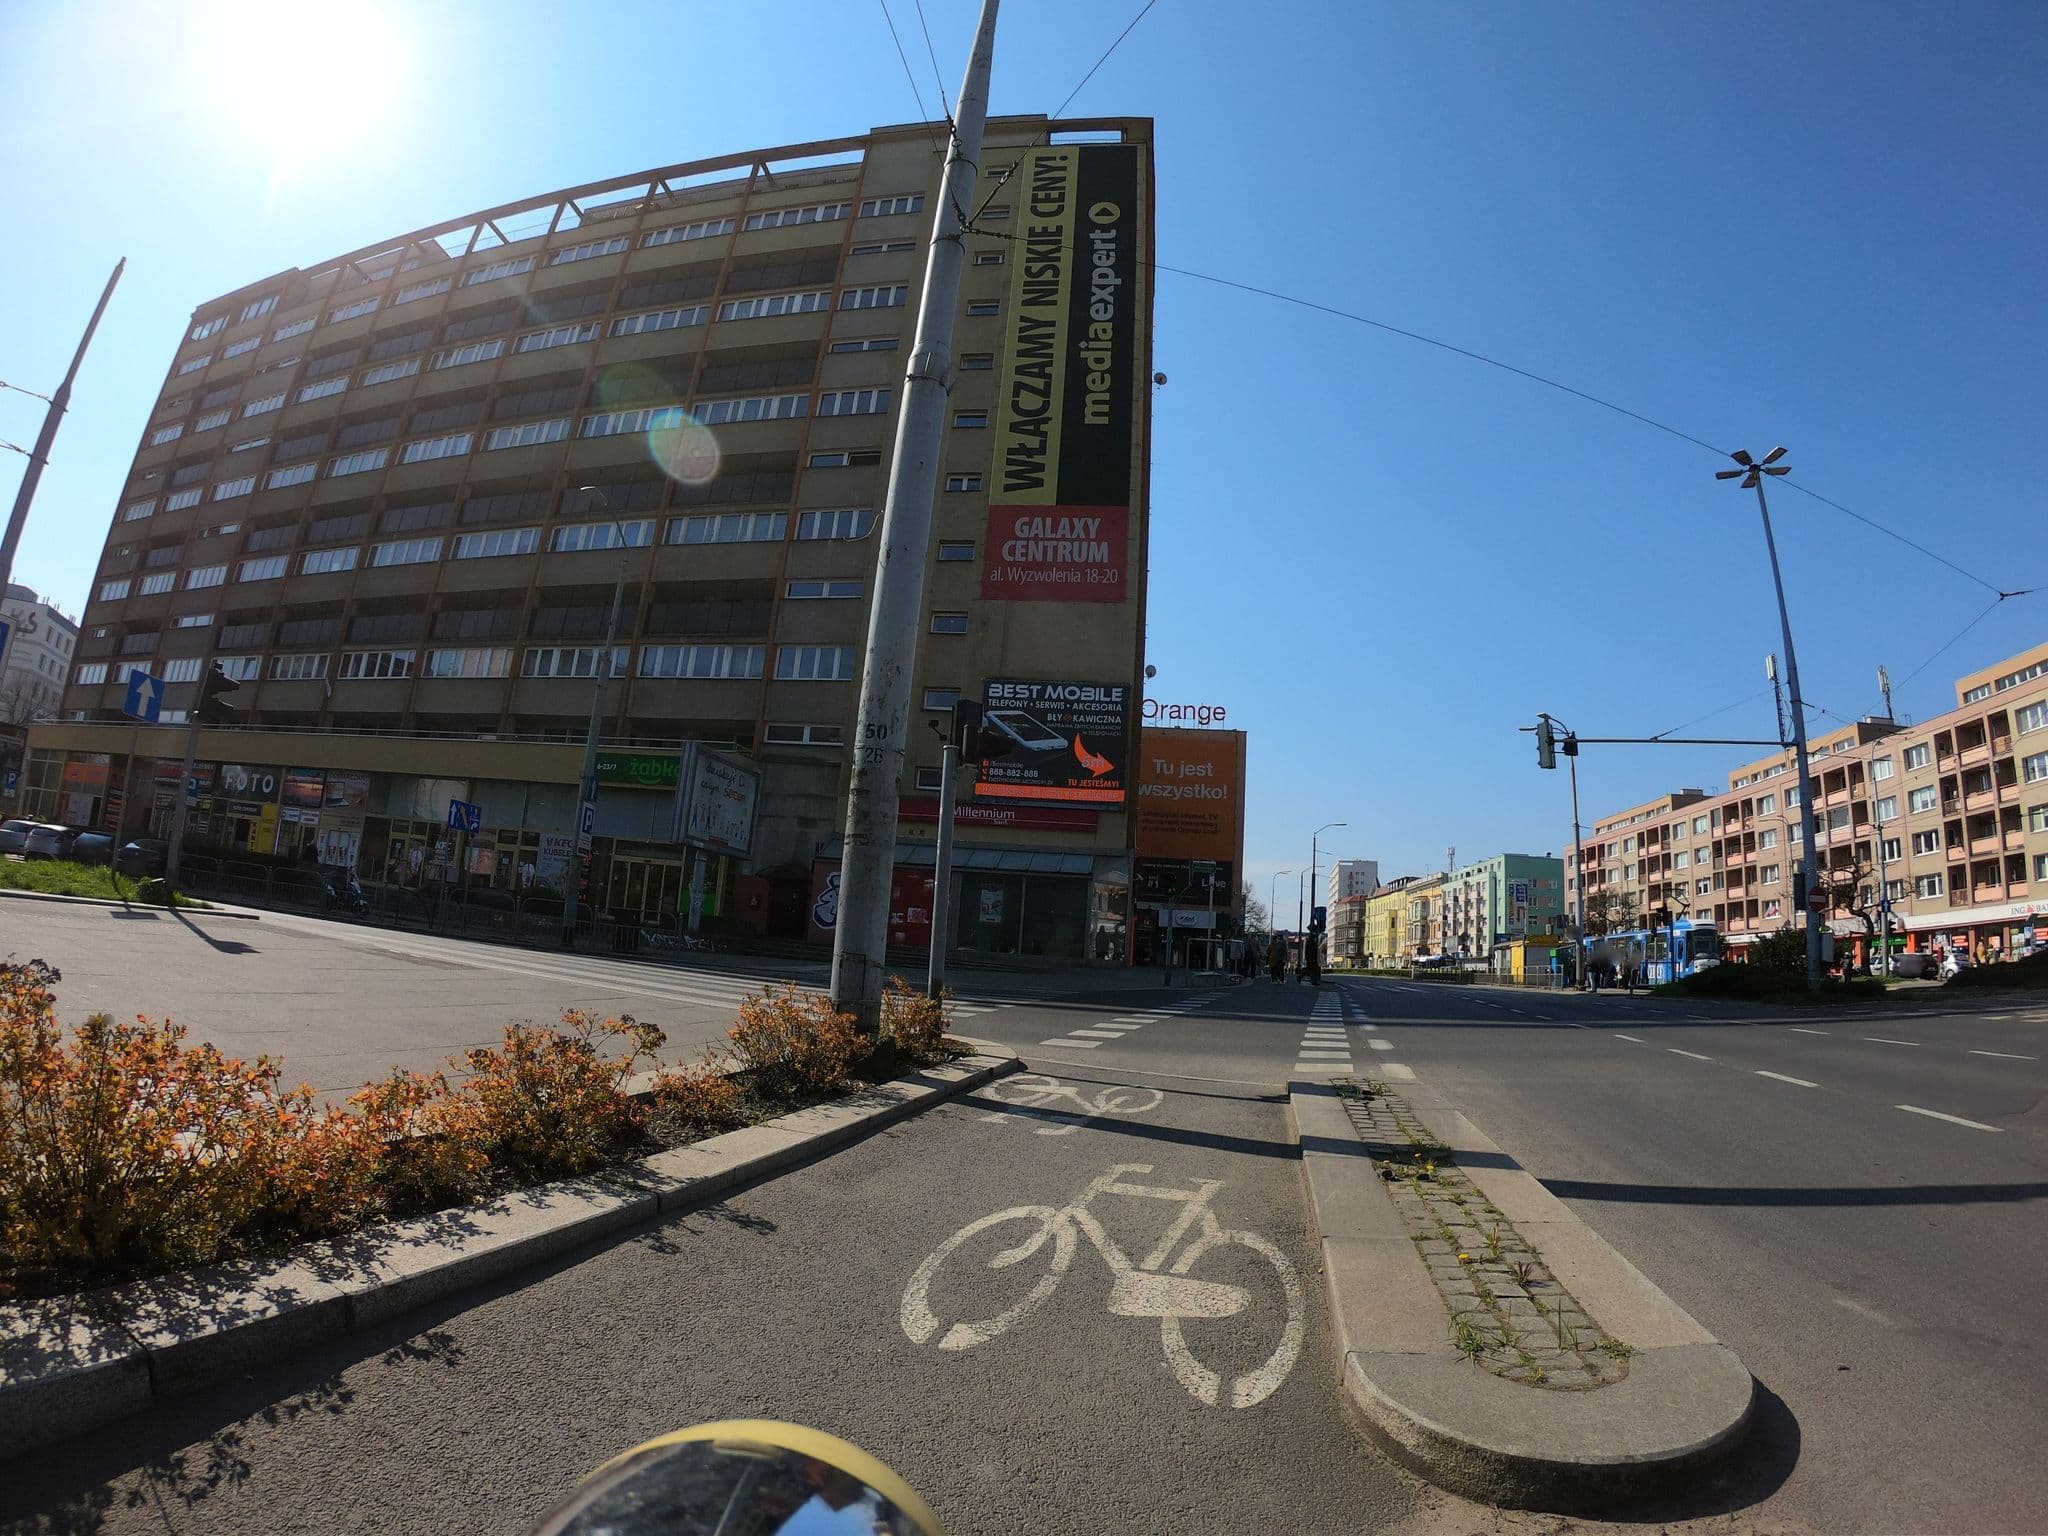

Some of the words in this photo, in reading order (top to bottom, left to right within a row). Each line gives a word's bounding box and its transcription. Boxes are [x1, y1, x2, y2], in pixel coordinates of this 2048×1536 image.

[1030, 154, 1070, 219] CENY!
[1022, 225, 1063, 306] NISKIE
[1078, 228, 1122, 425] mediaexpert
[1003, 315, 1057, 493] WŁĄCZAMY
[1014, 517, 1102, 539] GALAXY
[1001, 540, 1109, 563] CENTRUM
[990, 566, 1003, 582] al.
[1007, 566, 1081, 585] Wyzwolenia
[1085, 568, 1119, 584] 18-20
[988, 683, 1042, 699] BEST
[1044, 685, 1123, 702] MOBILE
[988, 698, 1028, 708] TELEFONY
[1035, 701, 1065, 710] SERWIS
[1072, 703, 1122, 712] AKCESORIA
[1141, 698, 1226, 726] Orange
[865, 723, 887, 740] 50
[863, 747, 884, 764] 26
[1152, 759, 1174, 774] Tu
[1178, 760, 1214, 778] jest
[224, 773, 275, 793] FOTO
[1137, 783, 1228, 801] wszystko!
